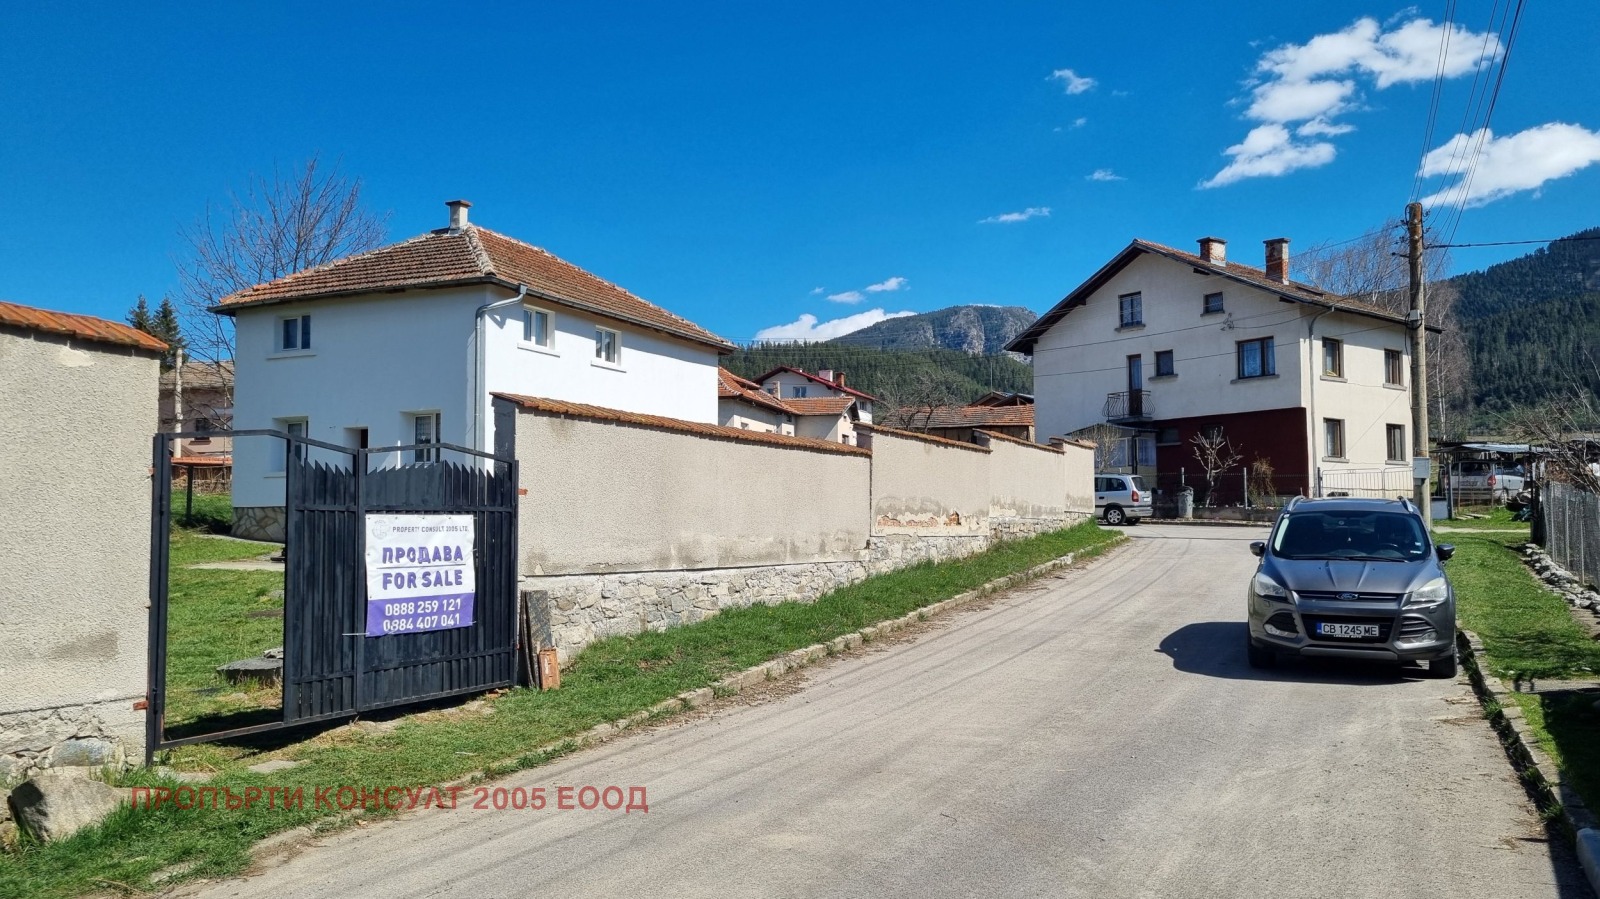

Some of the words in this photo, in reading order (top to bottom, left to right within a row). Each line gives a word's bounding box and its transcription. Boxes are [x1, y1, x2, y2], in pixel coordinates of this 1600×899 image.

[392, 525, 420, 533] PROPERTY
[421, 525, 445, 533] CONSULT
[382, 545, 463, 563] ПРОДАВА
[382, 571, 418, 590] FOR
[421, 569, 463, 588] SALE
[385, 602, 415, 616] 0888
[417, 600, 439, 613] 259
[442, 598, 461, 611] 121
[383, 617, 414, 632] 0884
[416, 615, 438, 629] 407
[440, 613, 461, 626] 041
[1339, 625, 1362, 635] 1245
